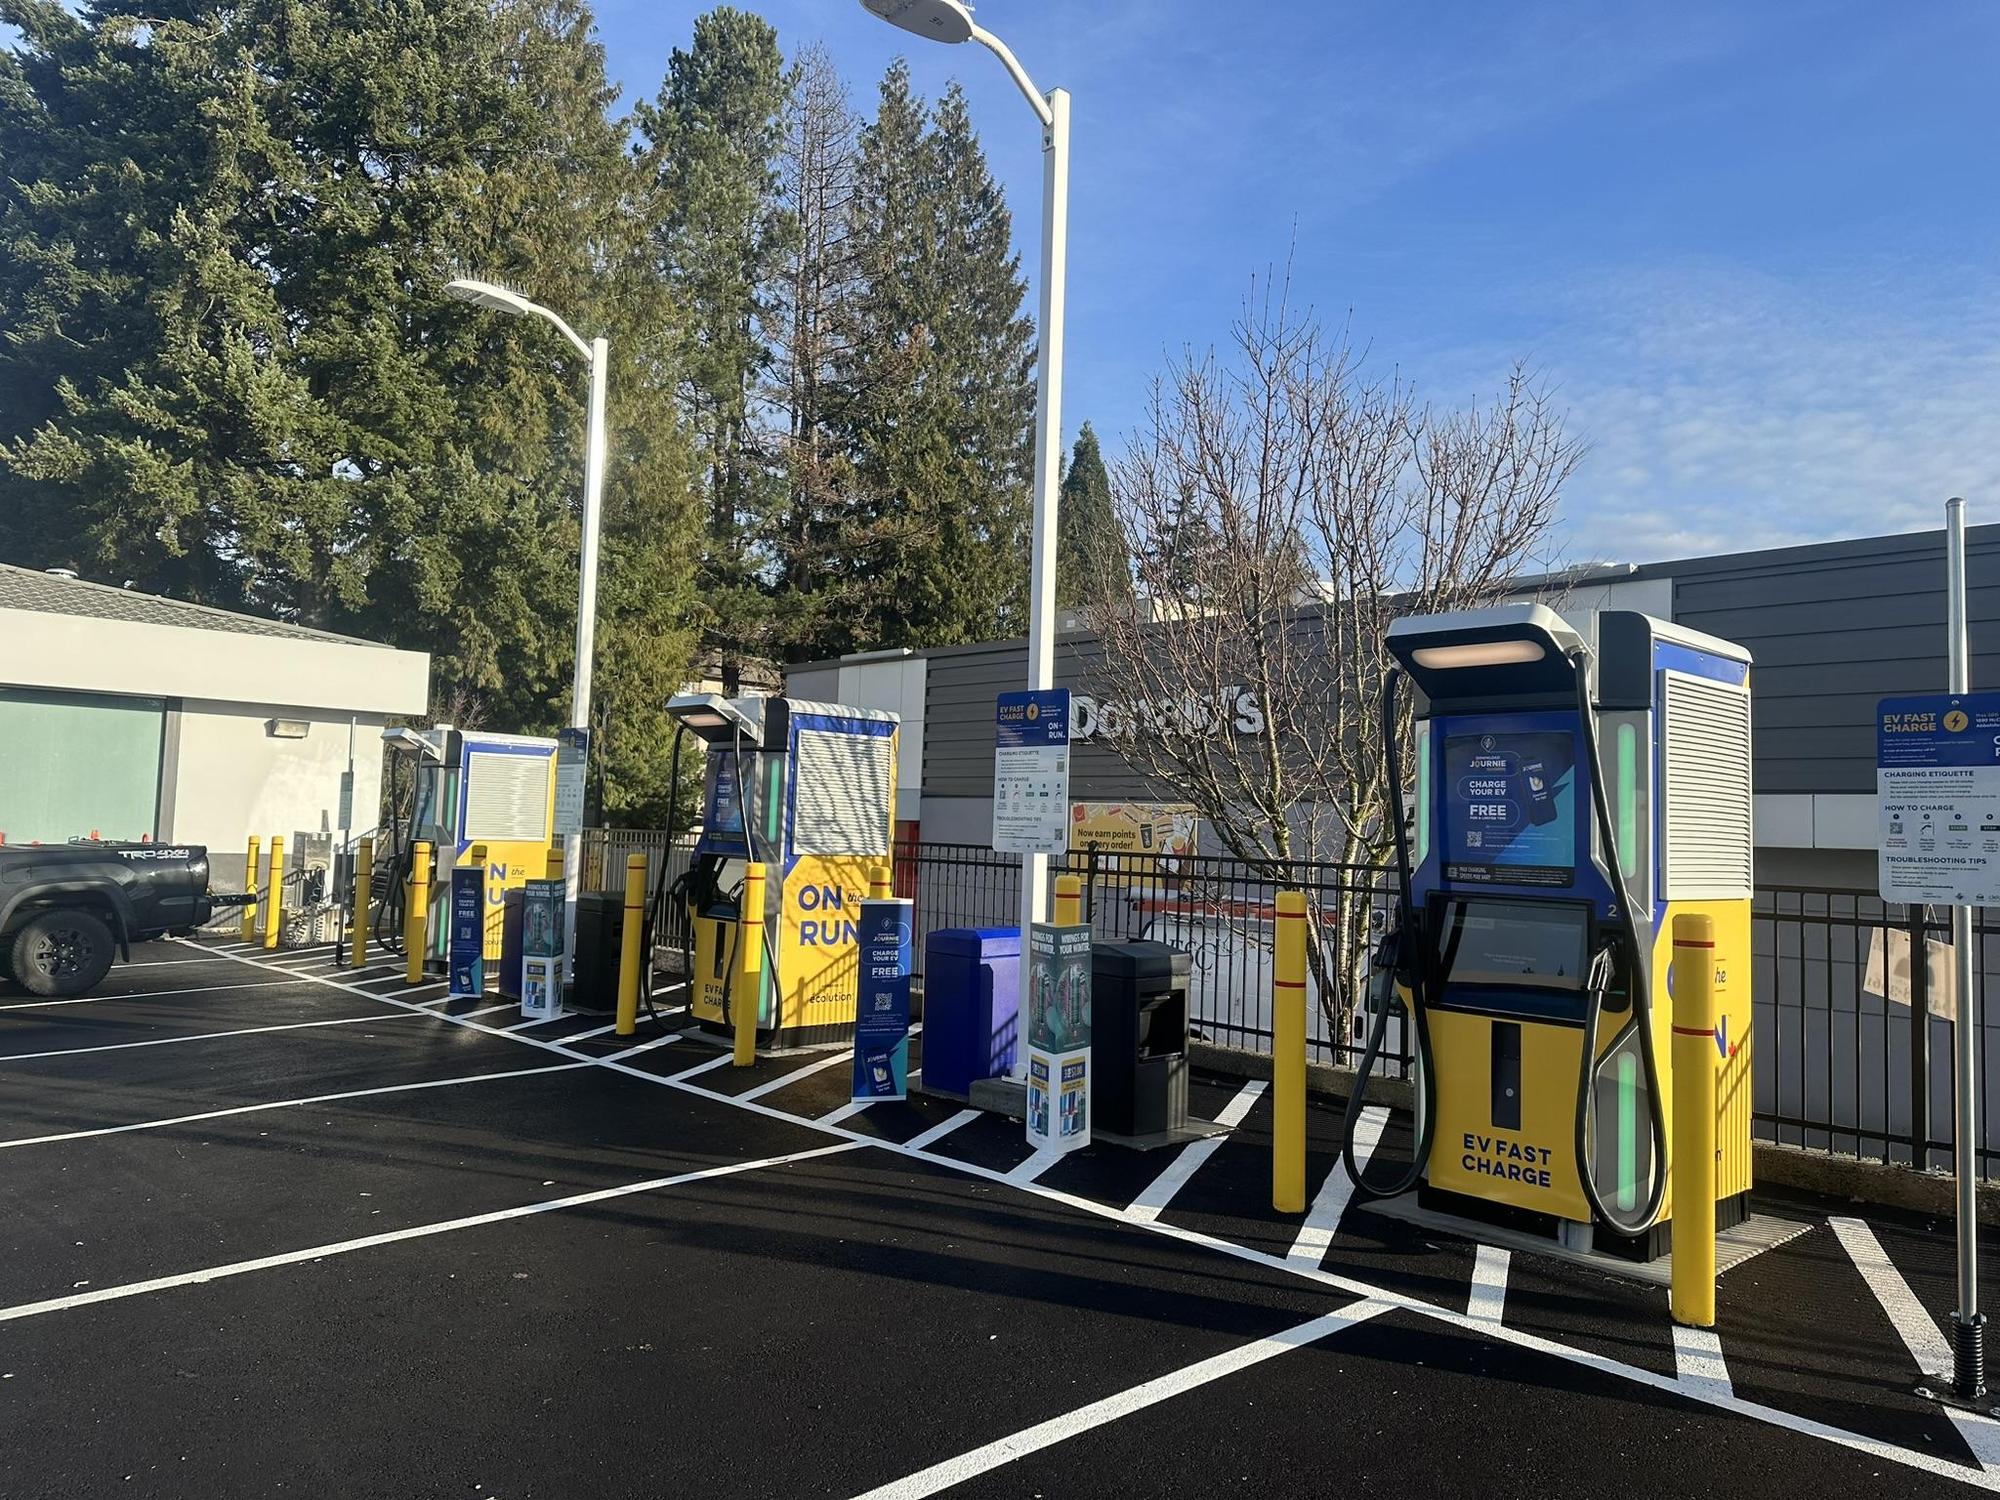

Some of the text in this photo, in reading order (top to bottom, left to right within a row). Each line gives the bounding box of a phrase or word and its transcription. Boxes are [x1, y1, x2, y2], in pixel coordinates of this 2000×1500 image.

[1009, 705, 1024, 713] FAST
[999, 712, 1024, 720] CHARGE
[1884, 713, 1937, 723] EV FAST
[1048, 722, 1059, 730] ON
[1884, 722, 1937, 733] CHARGE
[1470, 760, 1506, 768] JOURNIE
[1469, 780, 1507, 788] CHARGE
[1469, 788, 1507, 796] YOUR EV
[1469, 804, 1507, 816] FREE
[1077, 829, 1136, 840] Now earn points
[1111, 841, 1133, 850] order!
[1886, 856, 1987, 865] TROUBLESHOOTING TIPS
[798, 885, 842, 911] ON
[1607, 904, 1617, 918] 2
[872, 966, 898, 976] FREE
[1714, 967, 1727, 983] he
[1463, 1133, 1552, 1166] EV FAST
[1461, 1154, 1552, 1189] CHARGE
